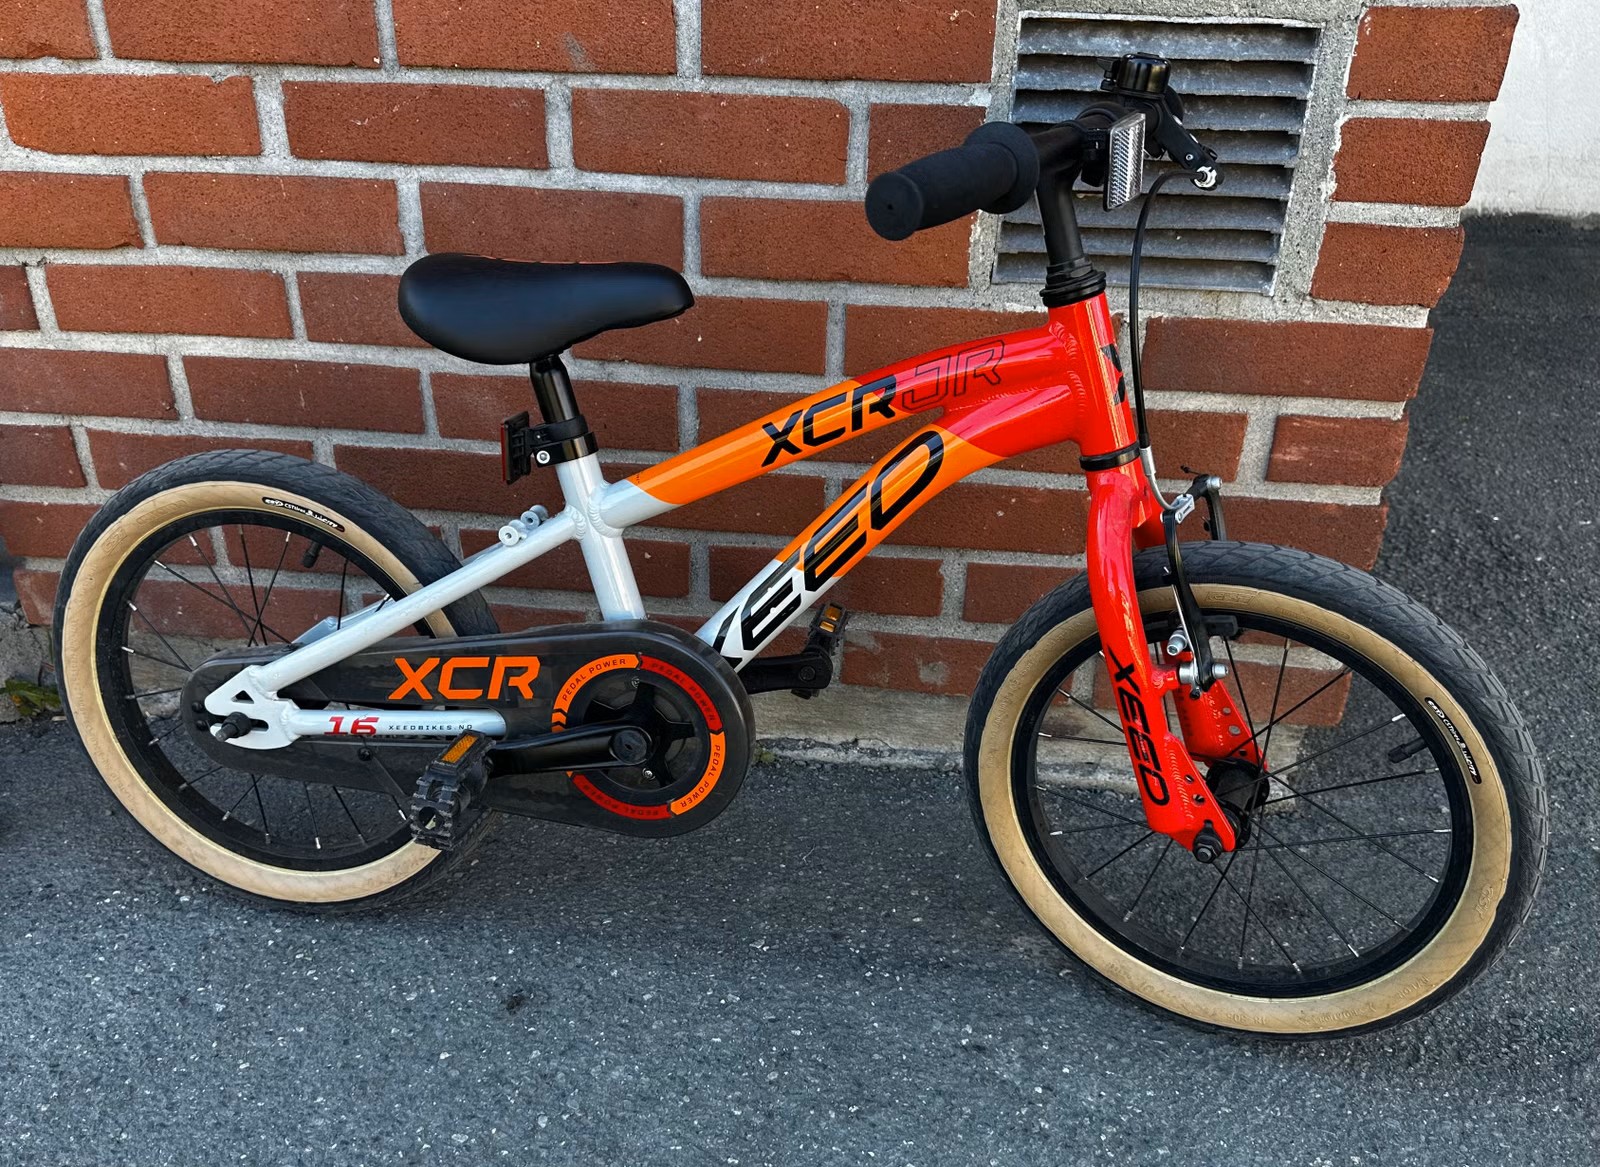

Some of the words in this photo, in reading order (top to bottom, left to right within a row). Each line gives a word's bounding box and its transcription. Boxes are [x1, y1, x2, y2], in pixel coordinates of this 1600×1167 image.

[760, 374, 897, 468] XCR
[902, 338, 1006, 411] JR
[388, 656, 540, 700] XCR
[562, 673, 587, 702] PEDAL
[588, 657, 627, 674] POWER
[651, 662, 686, 685] PEDAL
[689, 685, 716, 722] POWER
[324, 716, 381, 736] 16
[1106, 644, 1171, 807] XEED
[709, 744, 721, 777] PEDAL
[680, 780, 710, 808] POWER
